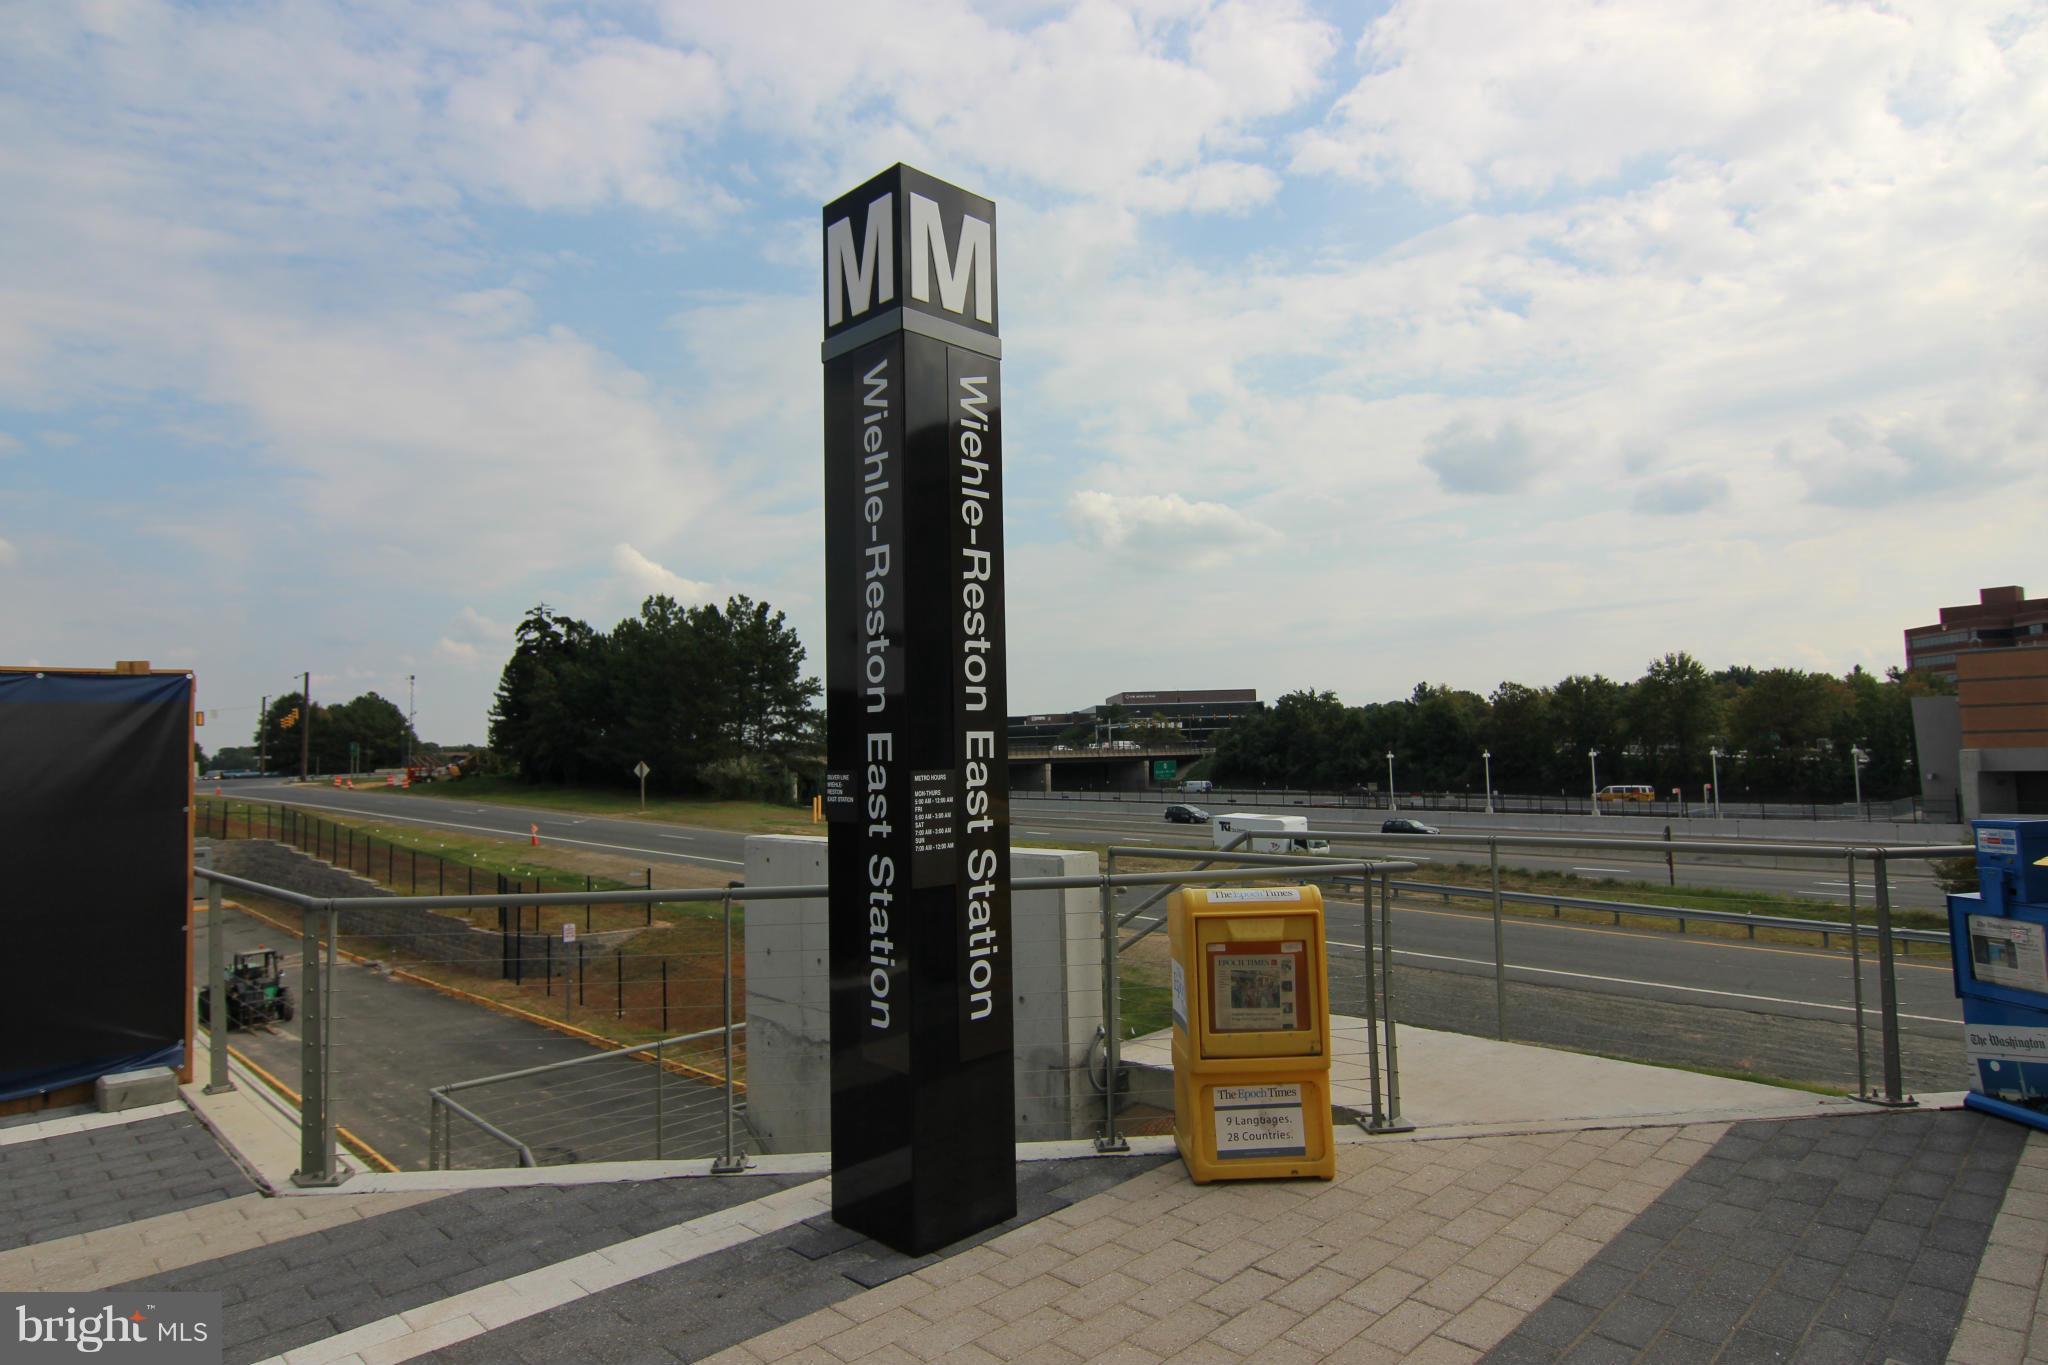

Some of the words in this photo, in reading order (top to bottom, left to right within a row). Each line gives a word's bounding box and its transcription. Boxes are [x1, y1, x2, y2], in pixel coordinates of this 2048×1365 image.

[827, 191, 894, 328] M
[909, 191, 993, 325] M
[863, 359, 890, 713] Wiehle-Reston
[959, 376, 992, 711] Wiehle-Reston
[867, 732, 893, 838] East
[965, 731, 995, 834] East
[868, 854, 896, 1029] Station
[967, 849, 998, 1021] Station
[1215, 890, 1232, 899] The
[1264, 889, 1294, 897] Times
[1217, 1089, 1238, 1100] The
[1238, 1087, 1267, 1101] Epoch
[1267, 1087, 1297, 1098] Times
[1970, 1033, 1988, 1047] The
[1988, 1031, 2046, 1052] Washington
[1226, 1116, 1232, 1126] 9
[1227, 1132, 1240, 1142] 28
[1242, 1130, 1294, 1141] Countries.
